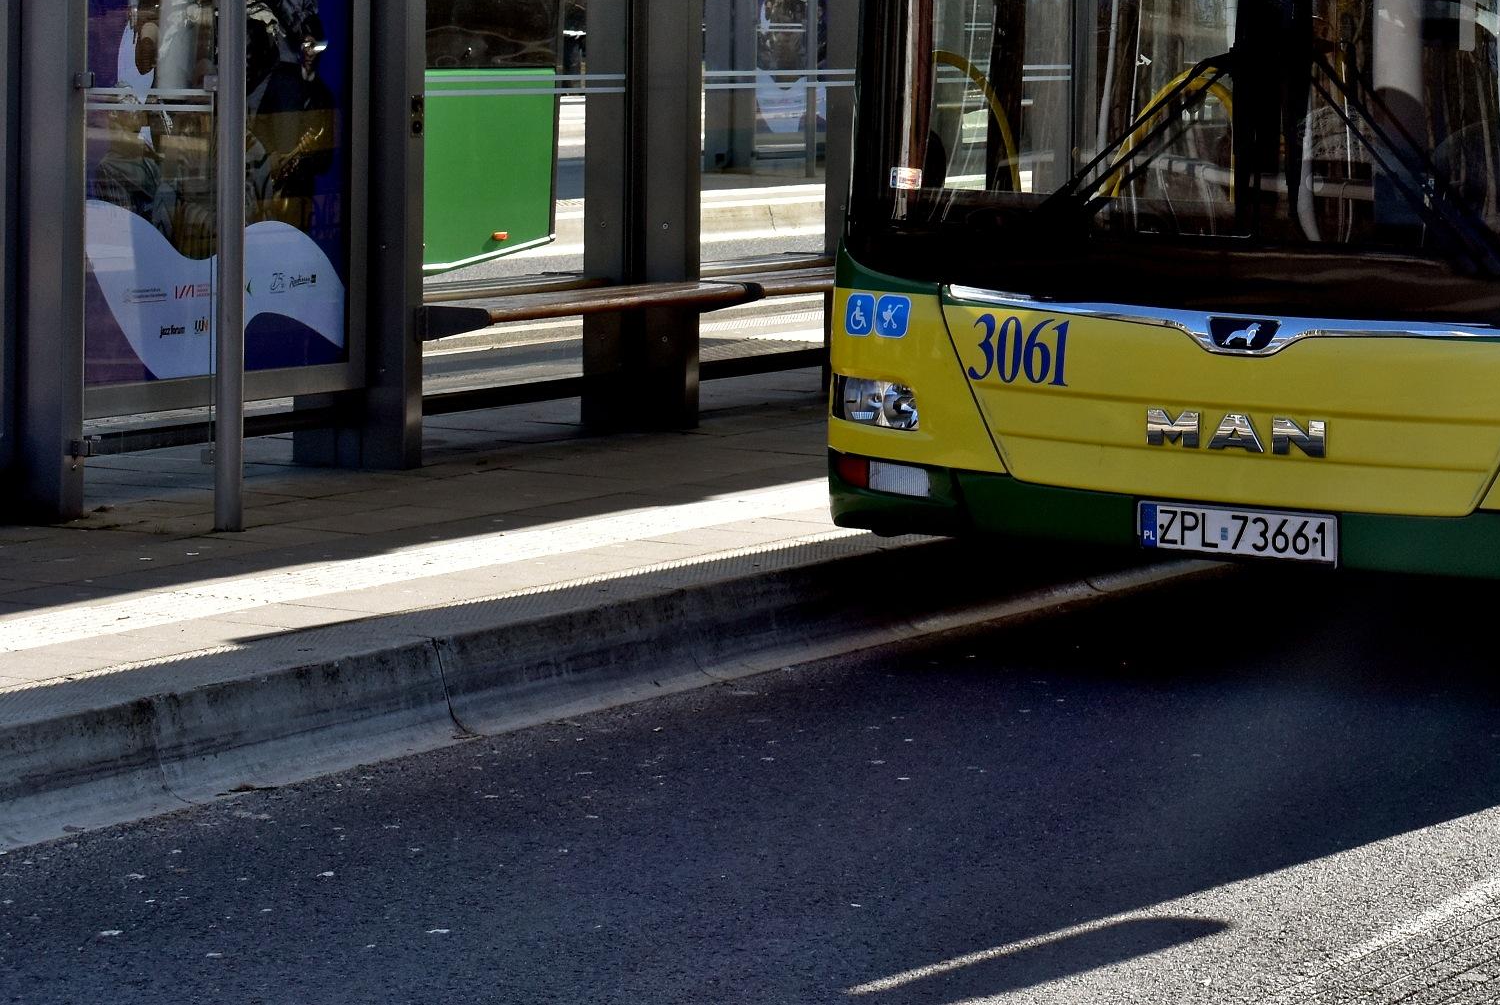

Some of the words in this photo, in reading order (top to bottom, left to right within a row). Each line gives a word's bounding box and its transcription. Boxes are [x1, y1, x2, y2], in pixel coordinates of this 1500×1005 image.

[967, 312, 1070, 387] 3061
[1147, 406, 1328, 459] MAN
[1143, 530, 1156, 541] PL
[1159, 509, 1219, 549] ZPL
[1231, 515, 1327, 557] 73661
